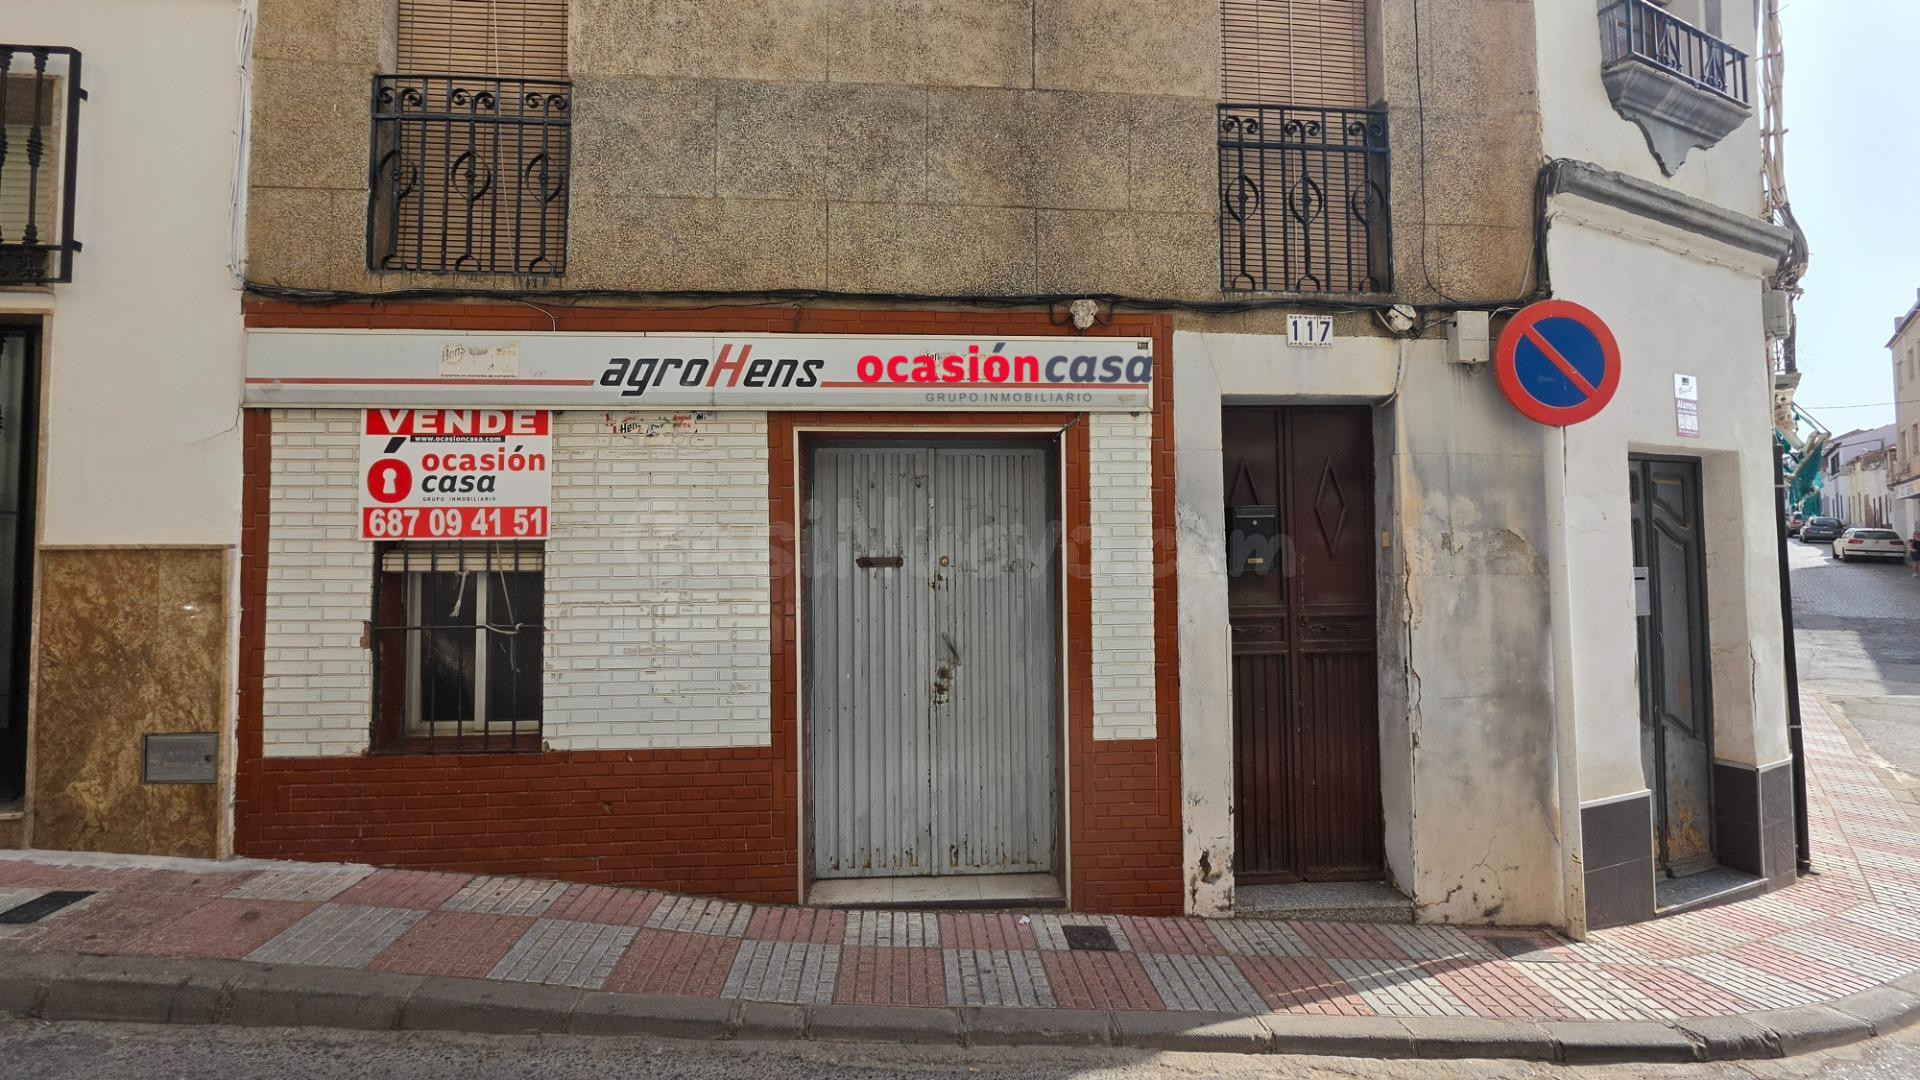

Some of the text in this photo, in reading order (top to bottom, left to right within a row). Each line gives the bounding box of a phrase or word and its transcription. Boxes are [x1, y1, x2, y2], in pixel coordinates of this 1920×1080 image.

[1292, 320, 1331, 342] 117
[600, 344, 825, 397] agroHens
[379, 409, 537, 434] VENDE
[414, 435, 502, 443] www.ocasioncasa.com
[421, 445, 546, 472] ocasión
[421, 474, 496, 493] casa
[369, 508, 543, 537] 687 09 41 51
